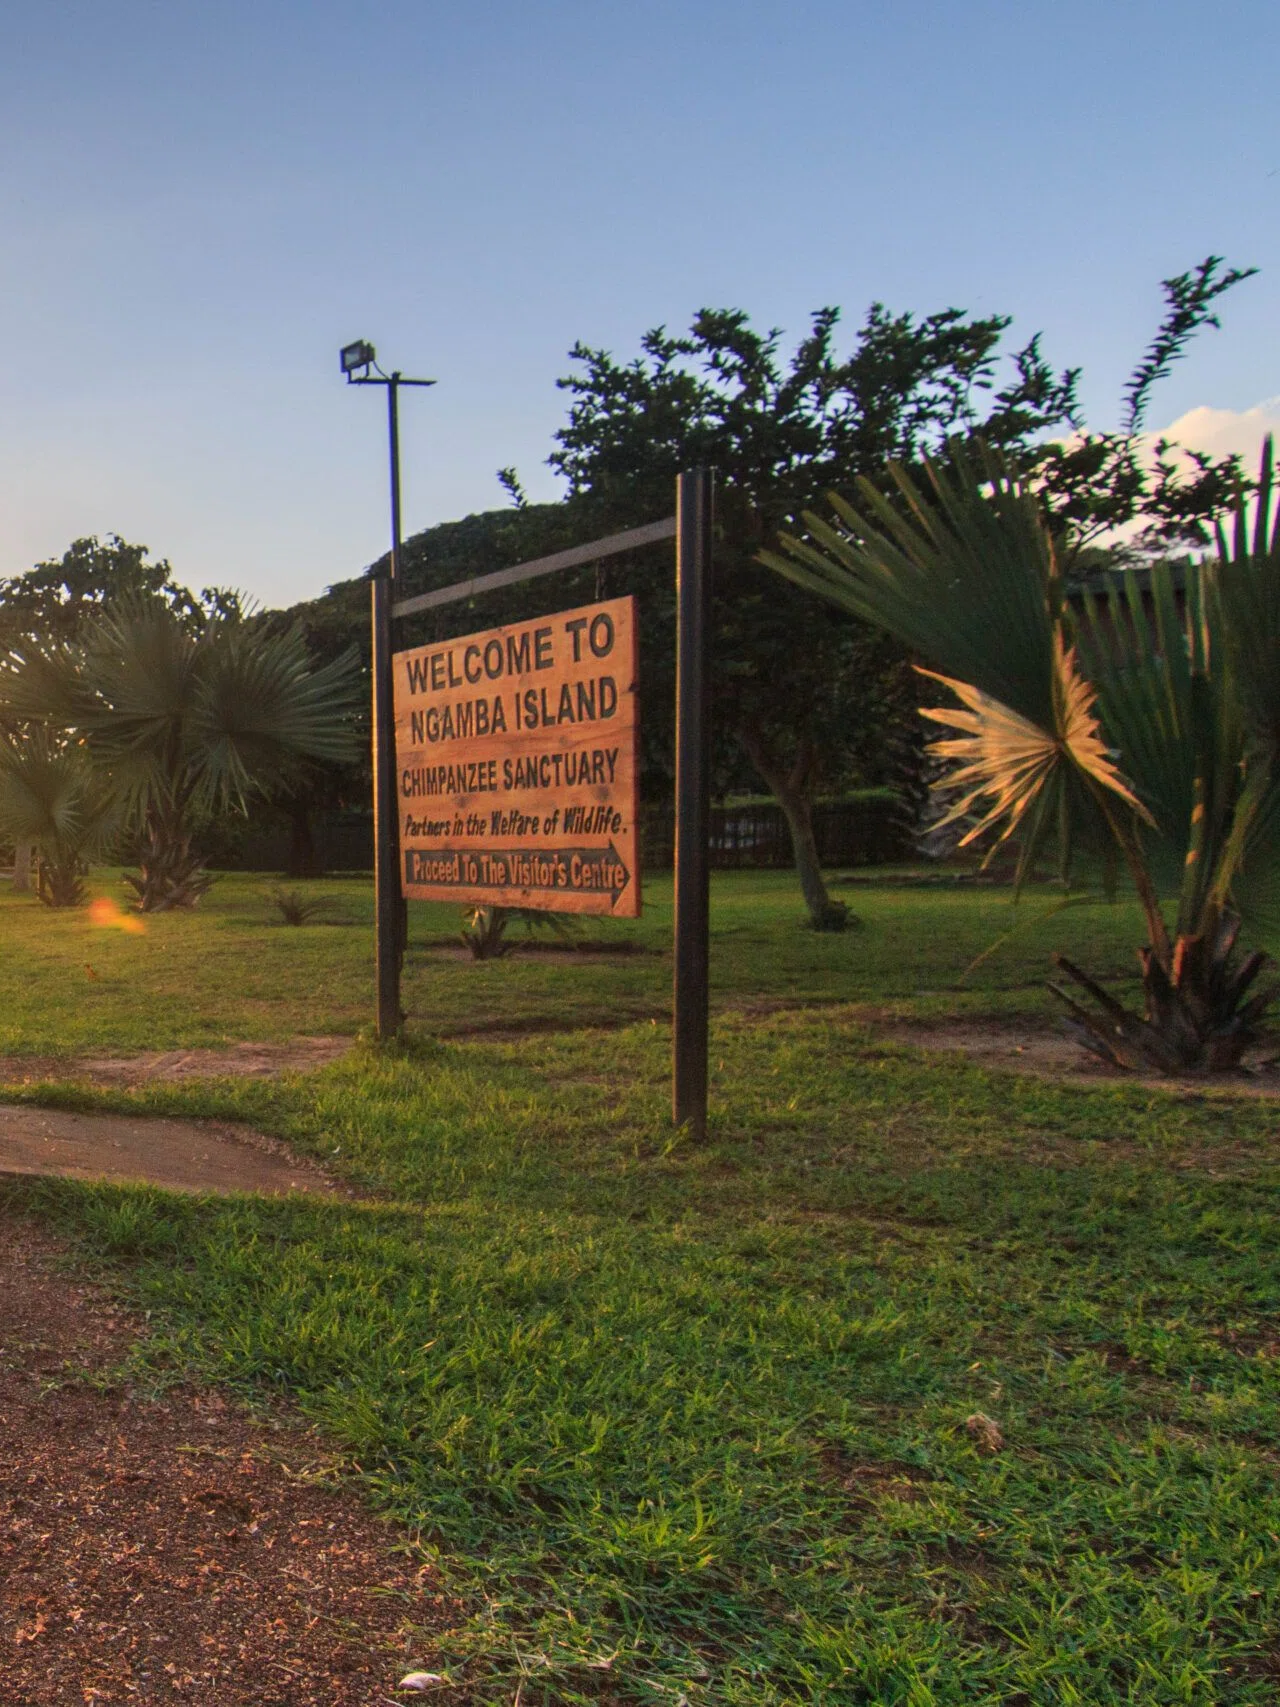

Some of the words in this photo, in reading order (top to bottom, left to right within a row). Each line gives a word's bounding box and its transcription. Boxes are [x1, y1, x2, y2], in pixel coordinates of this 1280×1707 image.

[406, 626, 554, 695] WELCOME
[565, 612, 615, 662] TO
[411, 695, 507, 744] NGAMBA
[515, 676, 618, 730] ISLAND
[402, 760, 497, 798] CHIMPANZEE
[503, 748, 619, 790] SANCTUARY
[404, 813, 450, 836] Partners
[453, 813, 466, 835] in
[466, 813, 486, 836] the
[490, 810, 538, 836] Welfare
[544, 808, 560, 835] of
[413, 854, 459, 882] Proceed
[462, 854, 478, 884] To
[480, 854, 506, 884] The
[508, 854, 567, 887] Visitor's
[570, 854, 624, 889] Centre
